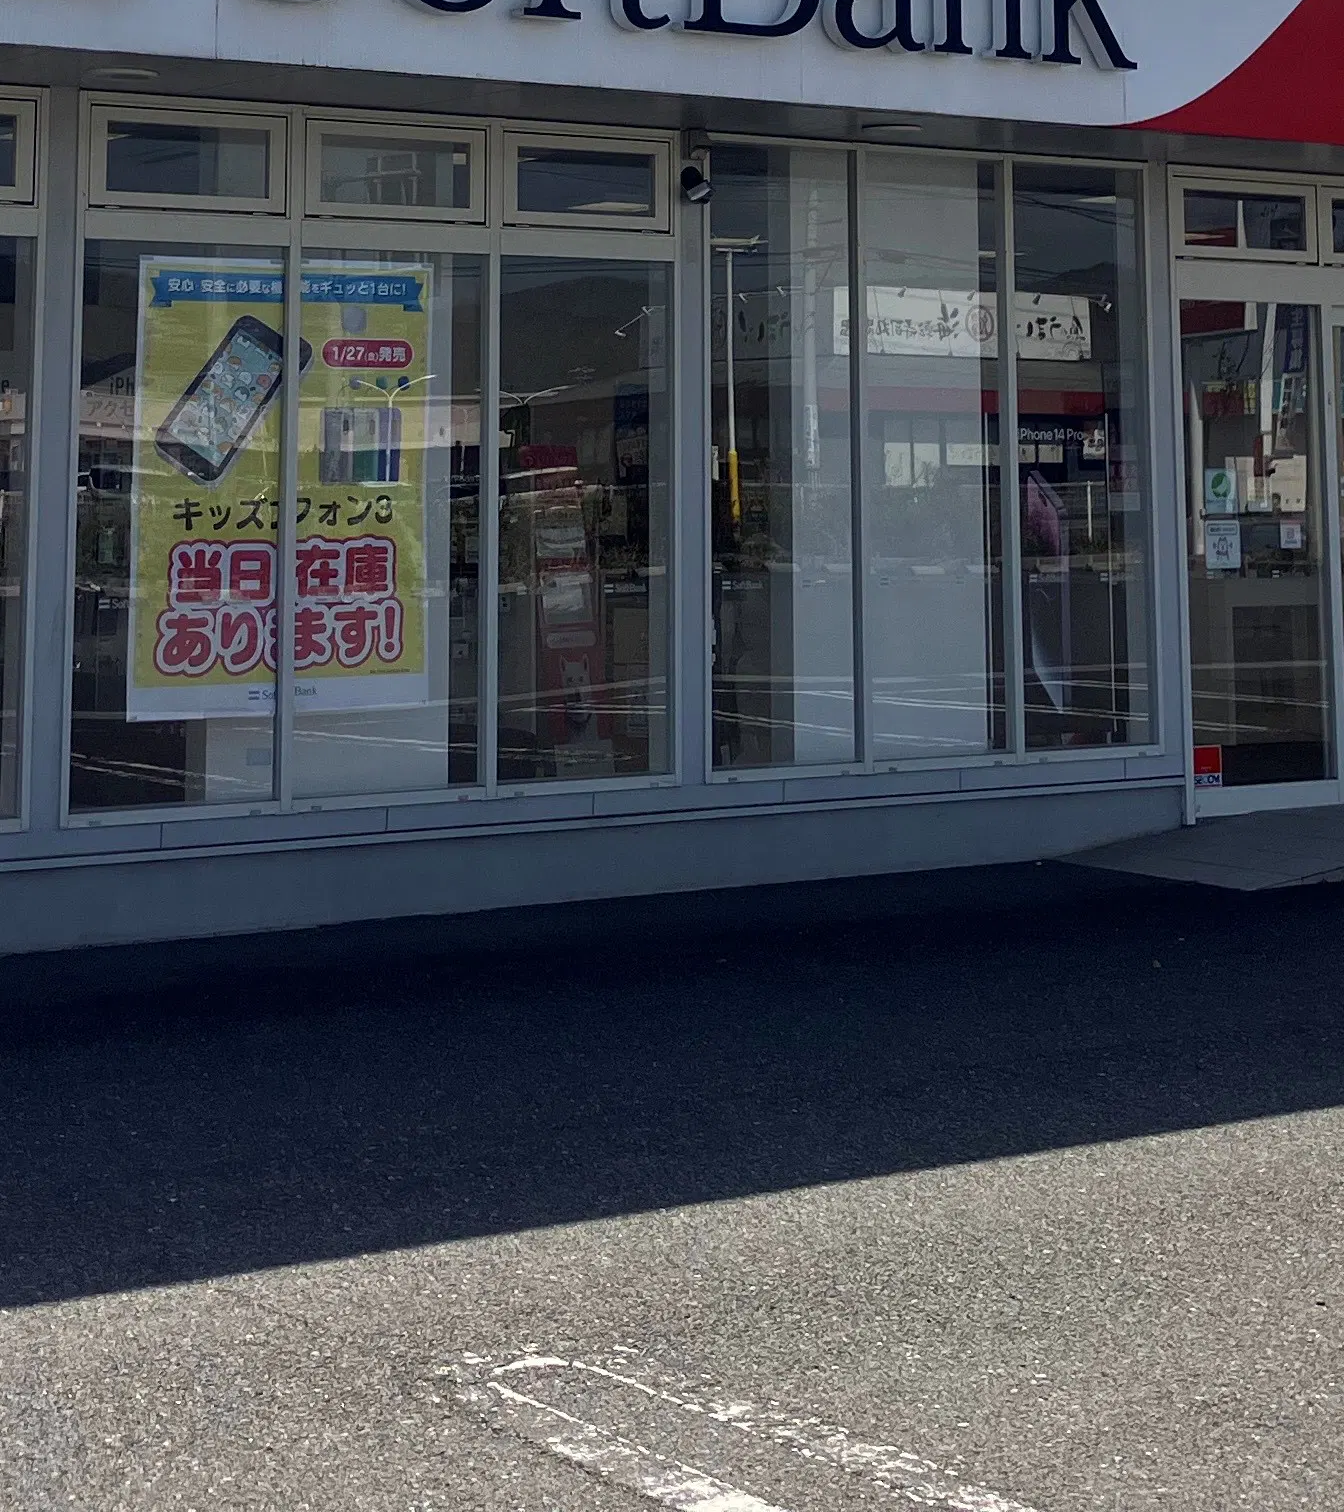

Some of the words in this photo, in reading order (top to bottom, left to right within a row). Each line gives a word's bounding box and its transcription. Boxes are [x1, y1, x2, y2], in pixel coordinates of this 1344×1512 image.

[1017, 428, 1052, 442] Phone
[173, 494, 393, 531] キッズフォン3
[172, 538, 393, 605] 当日在庫
[161, 604, 399, 668] あります!
